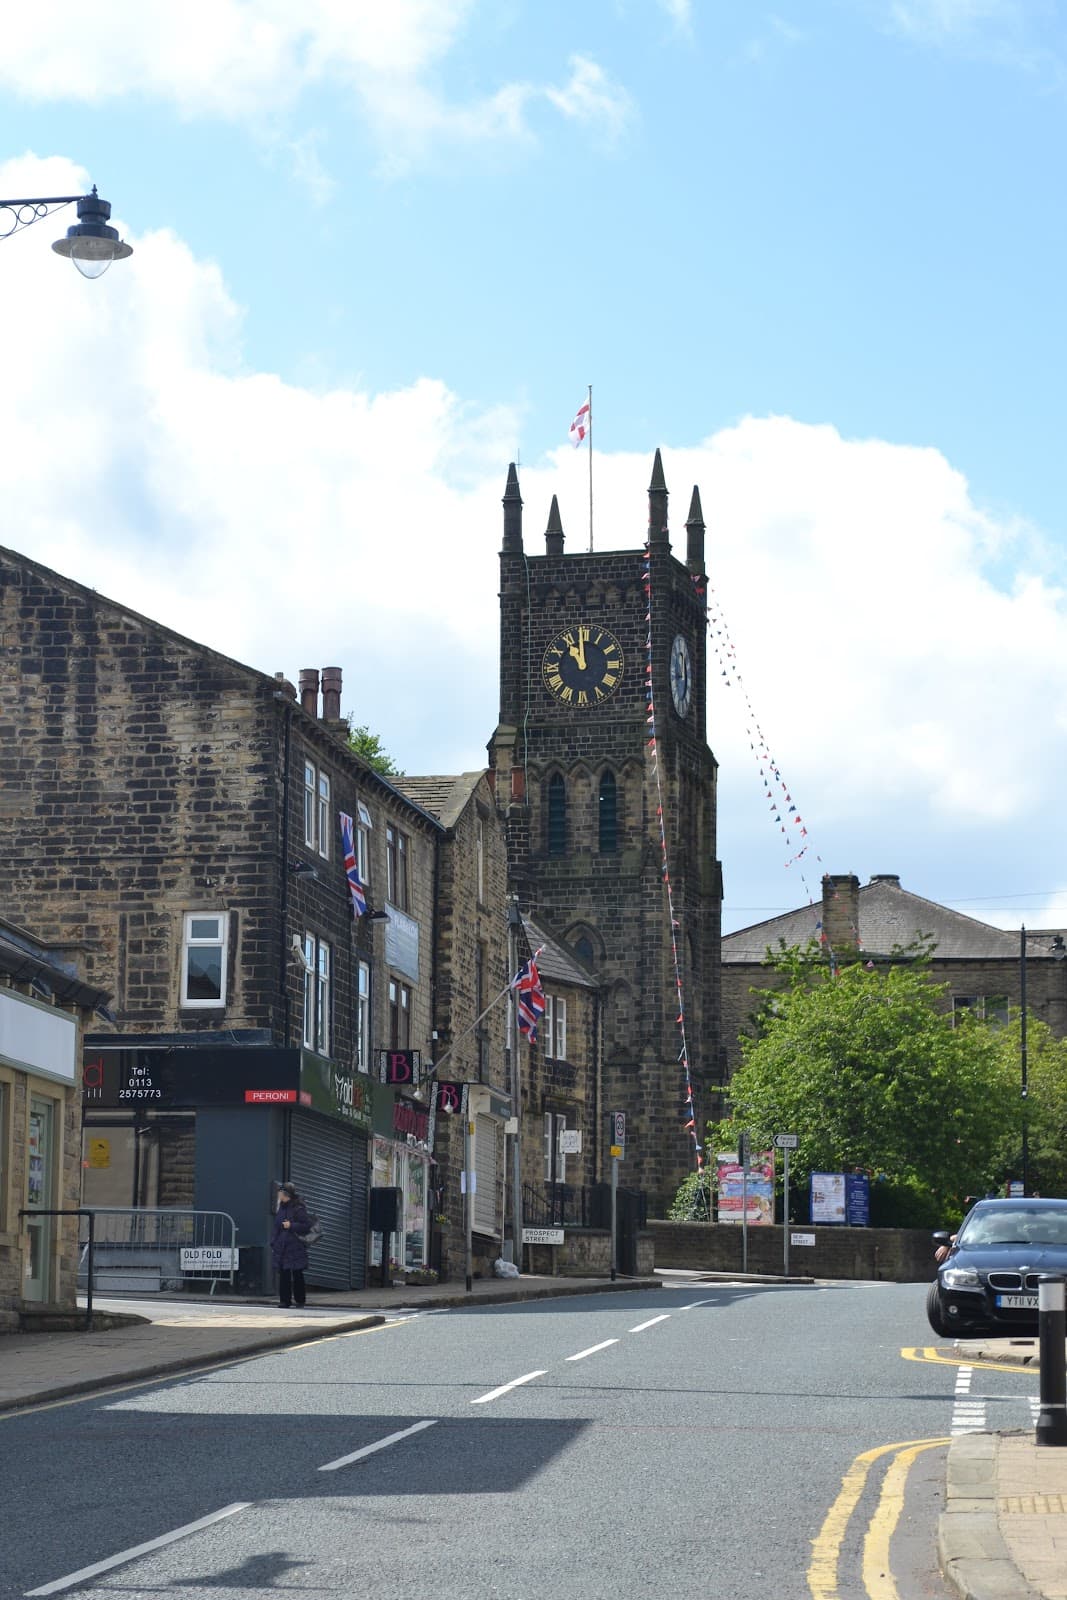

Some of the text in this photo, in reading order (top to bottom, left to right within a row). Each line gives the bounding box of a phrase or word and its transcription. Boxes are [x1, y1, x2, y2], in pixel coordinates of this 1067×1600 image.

[132, 1067, 150, 1076] Tel:
[390, 1054, 411, 1082] B
[128, 1078, 152, 1087] 0113
[119, 1089, 162, 1098] 2575773
[252, 1092, 289, 1101] PERONI
[440, 1084, 458, 1110] B
[184, 1250, 222, 1259] OLD FOLD
